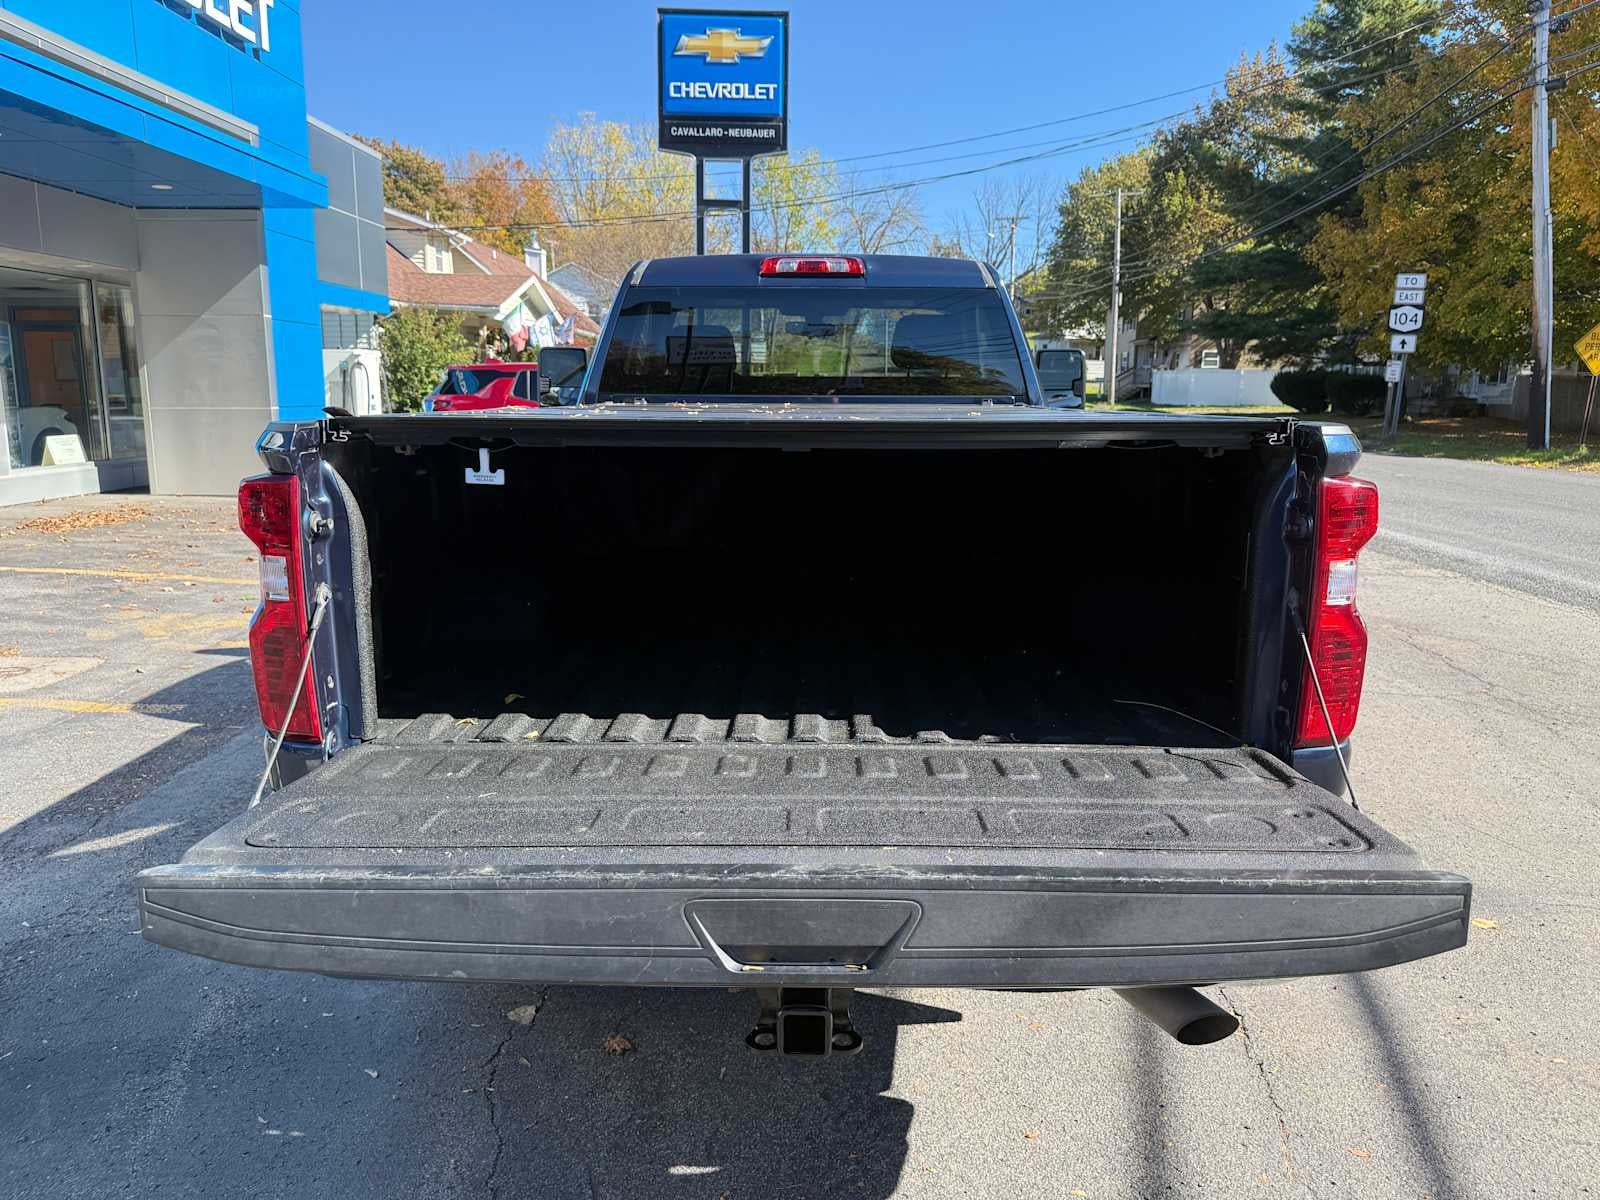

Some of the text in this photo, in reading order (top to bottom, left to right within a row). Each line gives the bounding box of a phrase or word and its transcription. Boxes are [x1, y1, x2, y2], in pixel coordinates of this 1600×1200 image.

[669, 82, 778, 99] CHEVROLET
[670, 126, 776, 138] CAVALLARO-NEUBAUER
[1403, 277, 1418, 286] TO
[1399, 291, 1419, 301] EAST
[1394, 312, 1418, 326] 104
